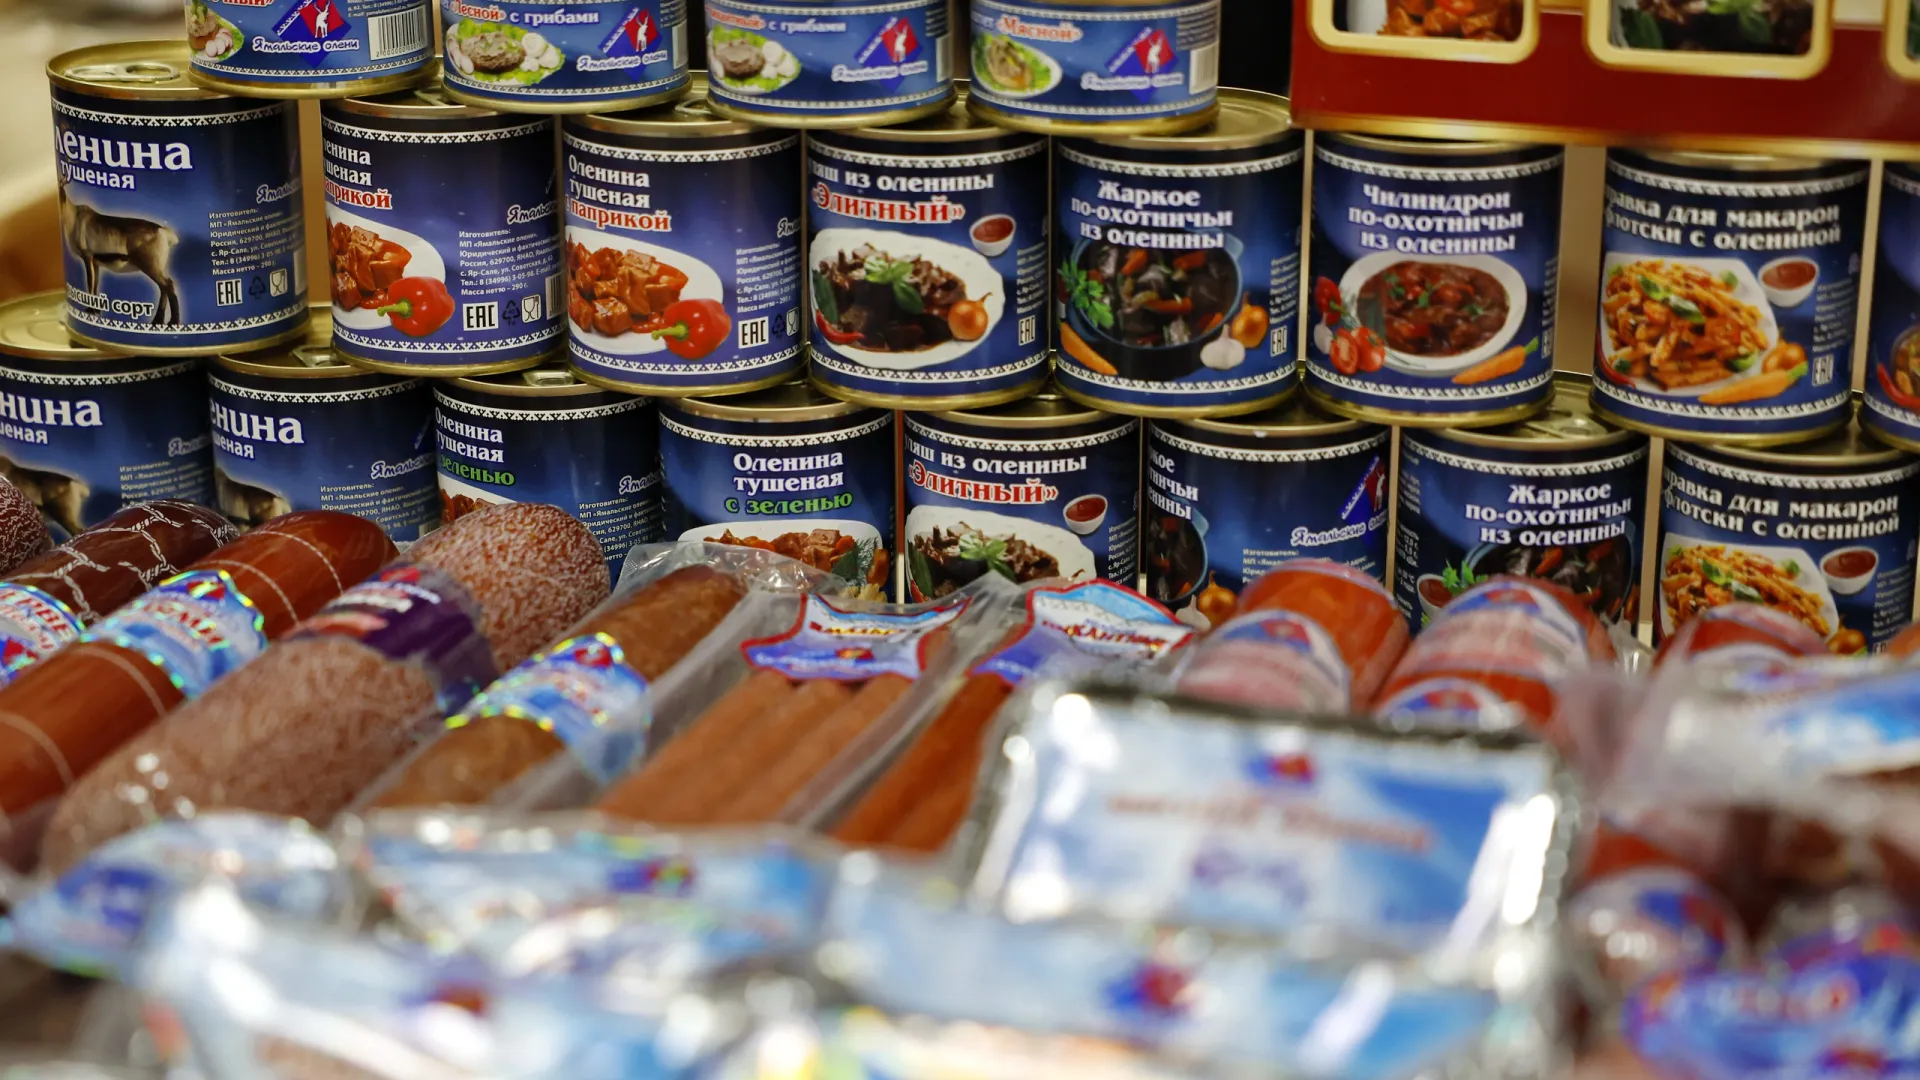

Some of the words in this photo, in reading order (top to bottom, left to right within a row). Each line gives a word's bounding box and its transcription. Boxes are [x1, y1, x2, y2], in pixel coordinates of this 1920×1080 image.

[510, 12, 520, 23] с
[524, 9, 599, 26] грибами
[252, 37, 320, 52] Ямальские
[323, 38, 359, 50] олени
[61, 160, 135, 189] тушеная
[568, 154, 651, 188] Оленина
[845, 170, 871, 189] из
[877, 173, 994, 193] оленины
[569, 178, 651, 209] тушеная
[811, 182, 966, 224] «Элитный»
[1097, 179, 1201, 209] Жаркое
[1363, 183, 1511, 216] Чилиндрон
[209, 208, 259, 219] Изготовитель:
[571, 200, 671, 231] паприкой
[1071, 198, 1234, 228] по-охотничьи
[1348, 206, 1524, 233] по-охотничьи
[1666, 204, 1718, 227] для
[1726, 205, 1840, 231] макарон
[210, 226, 260, 239] Юридический
[210, 240, 239, 248] Россия,
[459, 229, 511, 238] Изготовитель:
[459, 240, 473, 248] МП
[473, 236, 515, 248] «Ямальские
[1080, 222, 1102, 241] из
[1107, 228, 1225, 249] оленины
[1360, 231, 1389, 250] из
[1396, 234, 1516, 255] оленины
[1690, 230, 1706, 248] с
[1713, 225, 1841, 251] олениной
[460, 247, 511, 259] Юридический
[460, 260, 489, 268] Россия,
[489, 256, 516, 266] 629700,
[212, 267, 235, 276] Масса
[236, 265, 256, 273] нетто
[468, 267, 501, 278] Яр-Сале,
[479, 278, 485, 286] 8
[485, 275, 512, 286] (34996)
[217, 280, 243, 305] EAC
[461, 288, 485, 296] Масса
[485, 286, 506, 295] нетто
[511, 283, 523, 291] 290
[112, 299, 155, 320] сорт
[466, 304, 496, 329] EAC
[737, 304, 758, 314] Масса
[741, 319, 766, 346] EAC
[435, 406, 504, 444] Оленина
[436, 428, 504, 463] тушеная
[440, 456, 516, 486] зеленью
[733, 451, 844, 472] Оленина
[941, 451, 966, 470] из
[972, 456, 1087, 475] оленины
[320, 483, 375, 493] Изготовитель:
[733, 471, 844, 496] тушеная
[908, 458, 1059, 505] «Элитный»
[321, 501, 375, 511] Юридический
[335, 491, 380, 501] «Ямальские
[579, 497, 629, 510] Изготовитель:
[725, 498, 740, 514] с
[746, 491, 853, 515] зеленью
[1507, 483, 1612, 509] Жаркое
[580, 511, 592, 519] МП
[592, 505, 632, 517] «Ямальские
[1465, 498, 1632, 526] по-охотничьи
[1728, 494, 1779, 516] для
[1788, 495, 1899, 523] макарон
[1290, 526, 1367, 547] Ямальские
[1480, 527, 1512, 545] из
[1519, 520, 1626, 547] оленины
[1752, 520, 1768, 537] с
[1776, 514, 1900, 541] олениной
